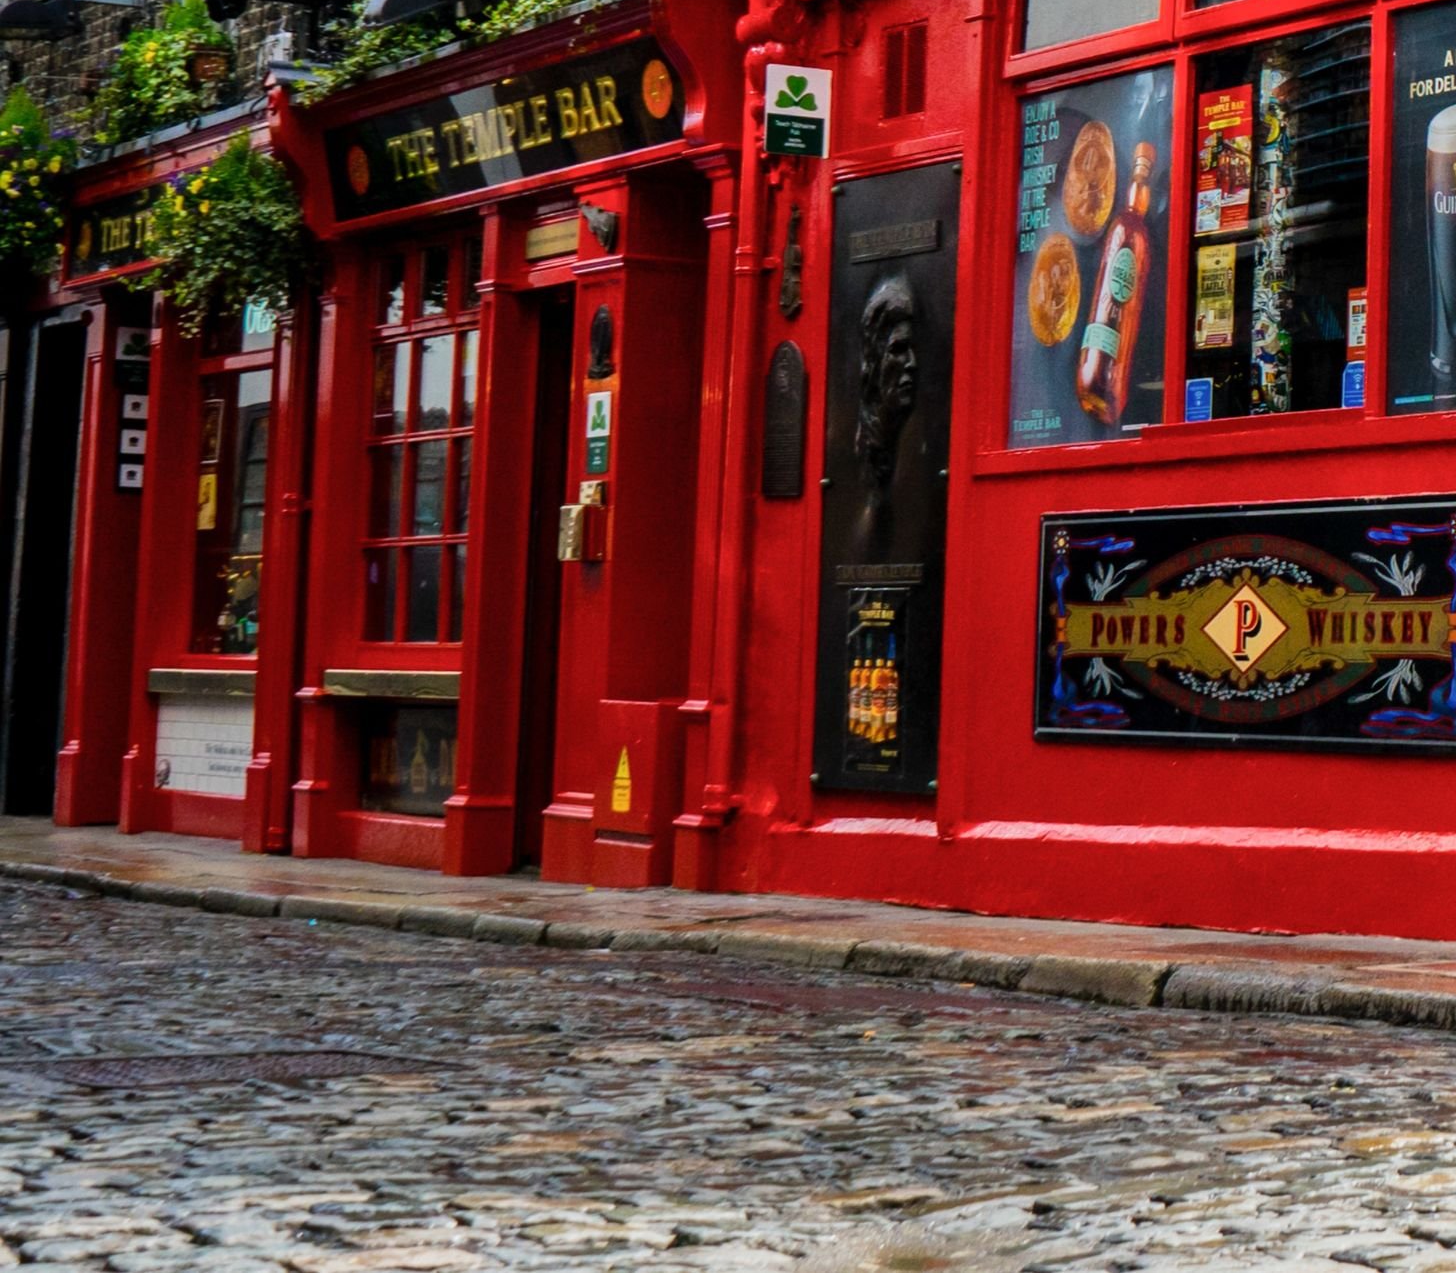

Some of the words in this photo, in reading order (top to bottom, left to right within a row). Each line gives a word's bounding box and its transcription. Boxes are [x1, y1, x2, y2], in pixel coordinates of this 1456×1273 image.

[1444, 49, 1454, 68] A
[1410, 78, 1434, 98] FOR
[386, 126, 440, 183] THE
[441, 94, 552, 168] TEMPLE
[554, 75, 624, 139] BAR
[1020, 208, 1051, 230] TEMPLE
[101, 216, 131, 253] THE
[1019, 232, 1036, 253] BAR
[1090, 610, 1187, 648] POWERS
[1232, 598, 1263, 662] P
[1306, 608, 1433, 647] WHISKEY
